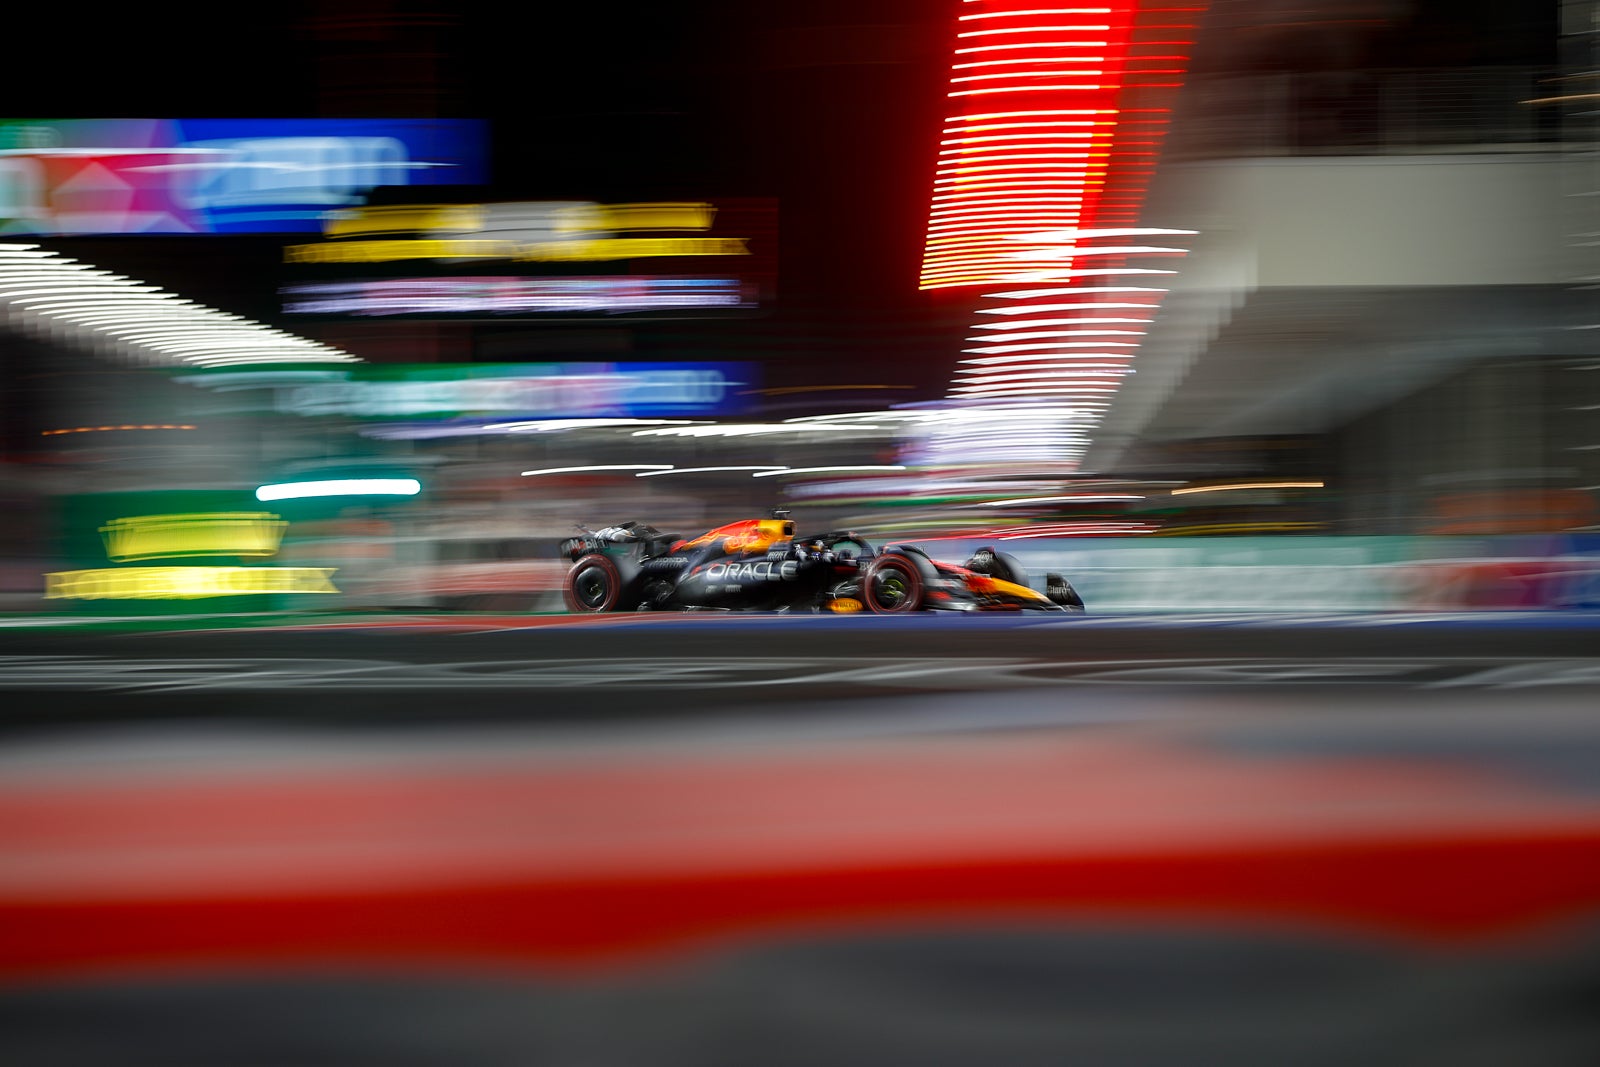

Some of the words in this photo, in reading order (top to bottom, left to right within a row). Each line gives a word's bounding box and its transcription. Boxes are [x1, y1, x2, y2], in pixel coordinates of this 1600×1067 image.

[569, 538, 599, 549] Mobil
[654, 556, 689, 565] HONDA
[704, 560, 799, 582] ORACLE
